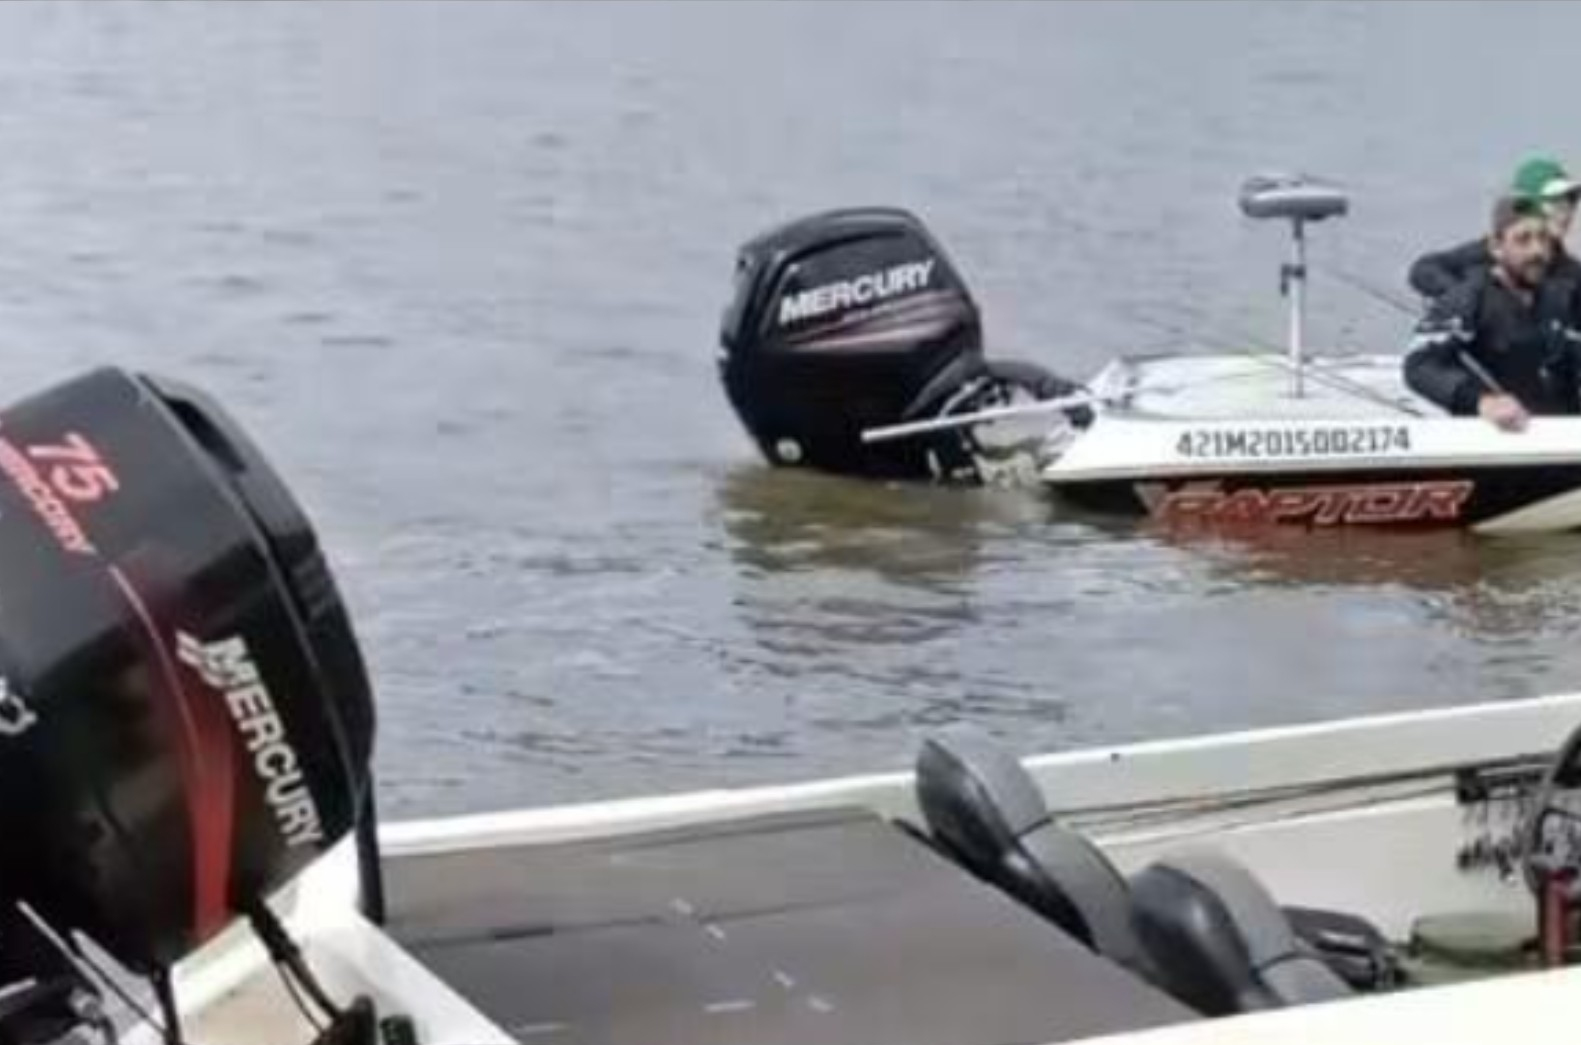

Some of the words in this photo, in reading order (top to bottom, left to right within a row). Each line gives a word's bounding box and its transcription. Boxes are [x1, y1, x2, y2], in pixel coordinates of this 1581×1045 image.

[779, 259, 935, 325] MERCURY
[27, 431, 119, 501] 75
[176, 629, 324, 847] MERCURY
